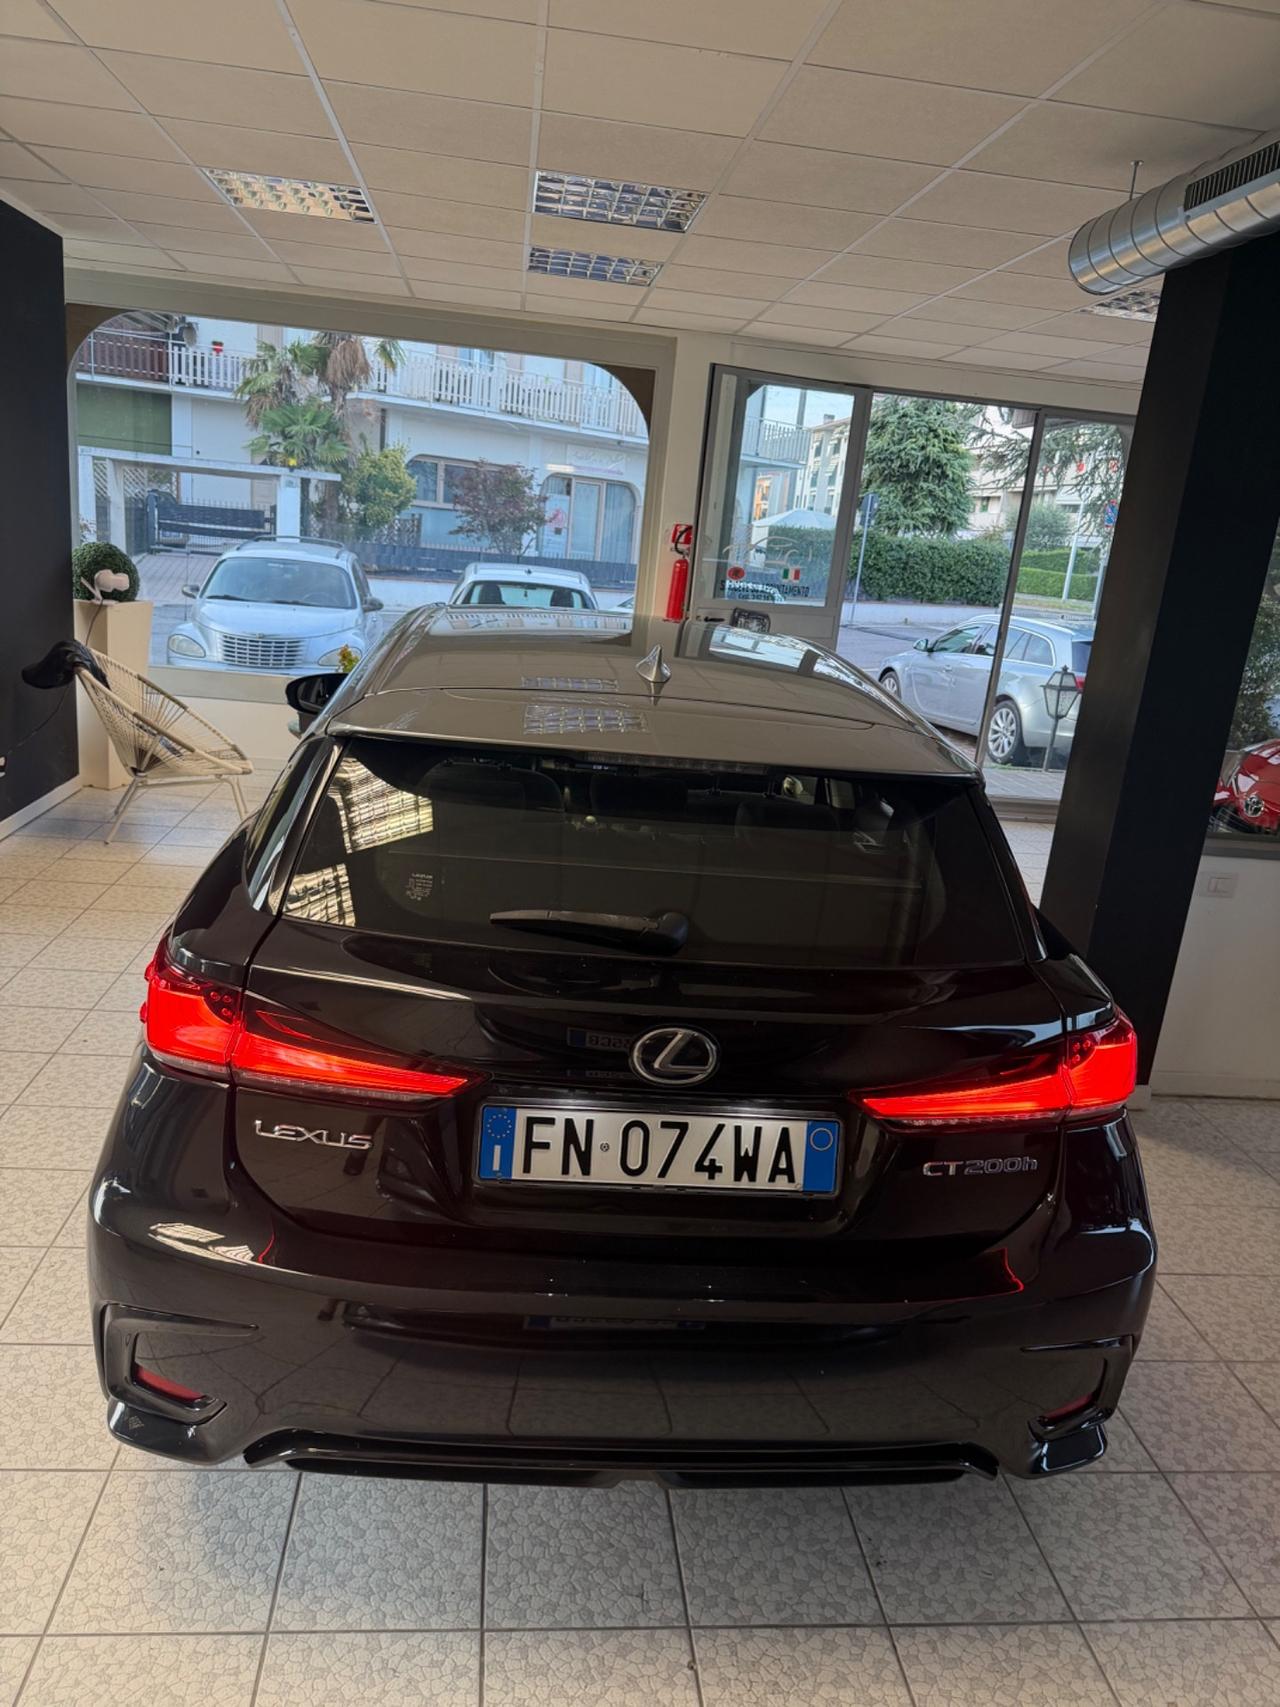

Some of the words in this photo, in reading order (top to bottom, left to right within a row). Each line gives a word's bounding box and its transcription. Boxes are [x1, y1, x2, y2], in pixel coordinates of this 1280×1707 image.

[254, 1119, 372, 1150] LEXUS
[523, 1116, 594, 1177] FN
[620, 1119, 797, 1184] 074WA
